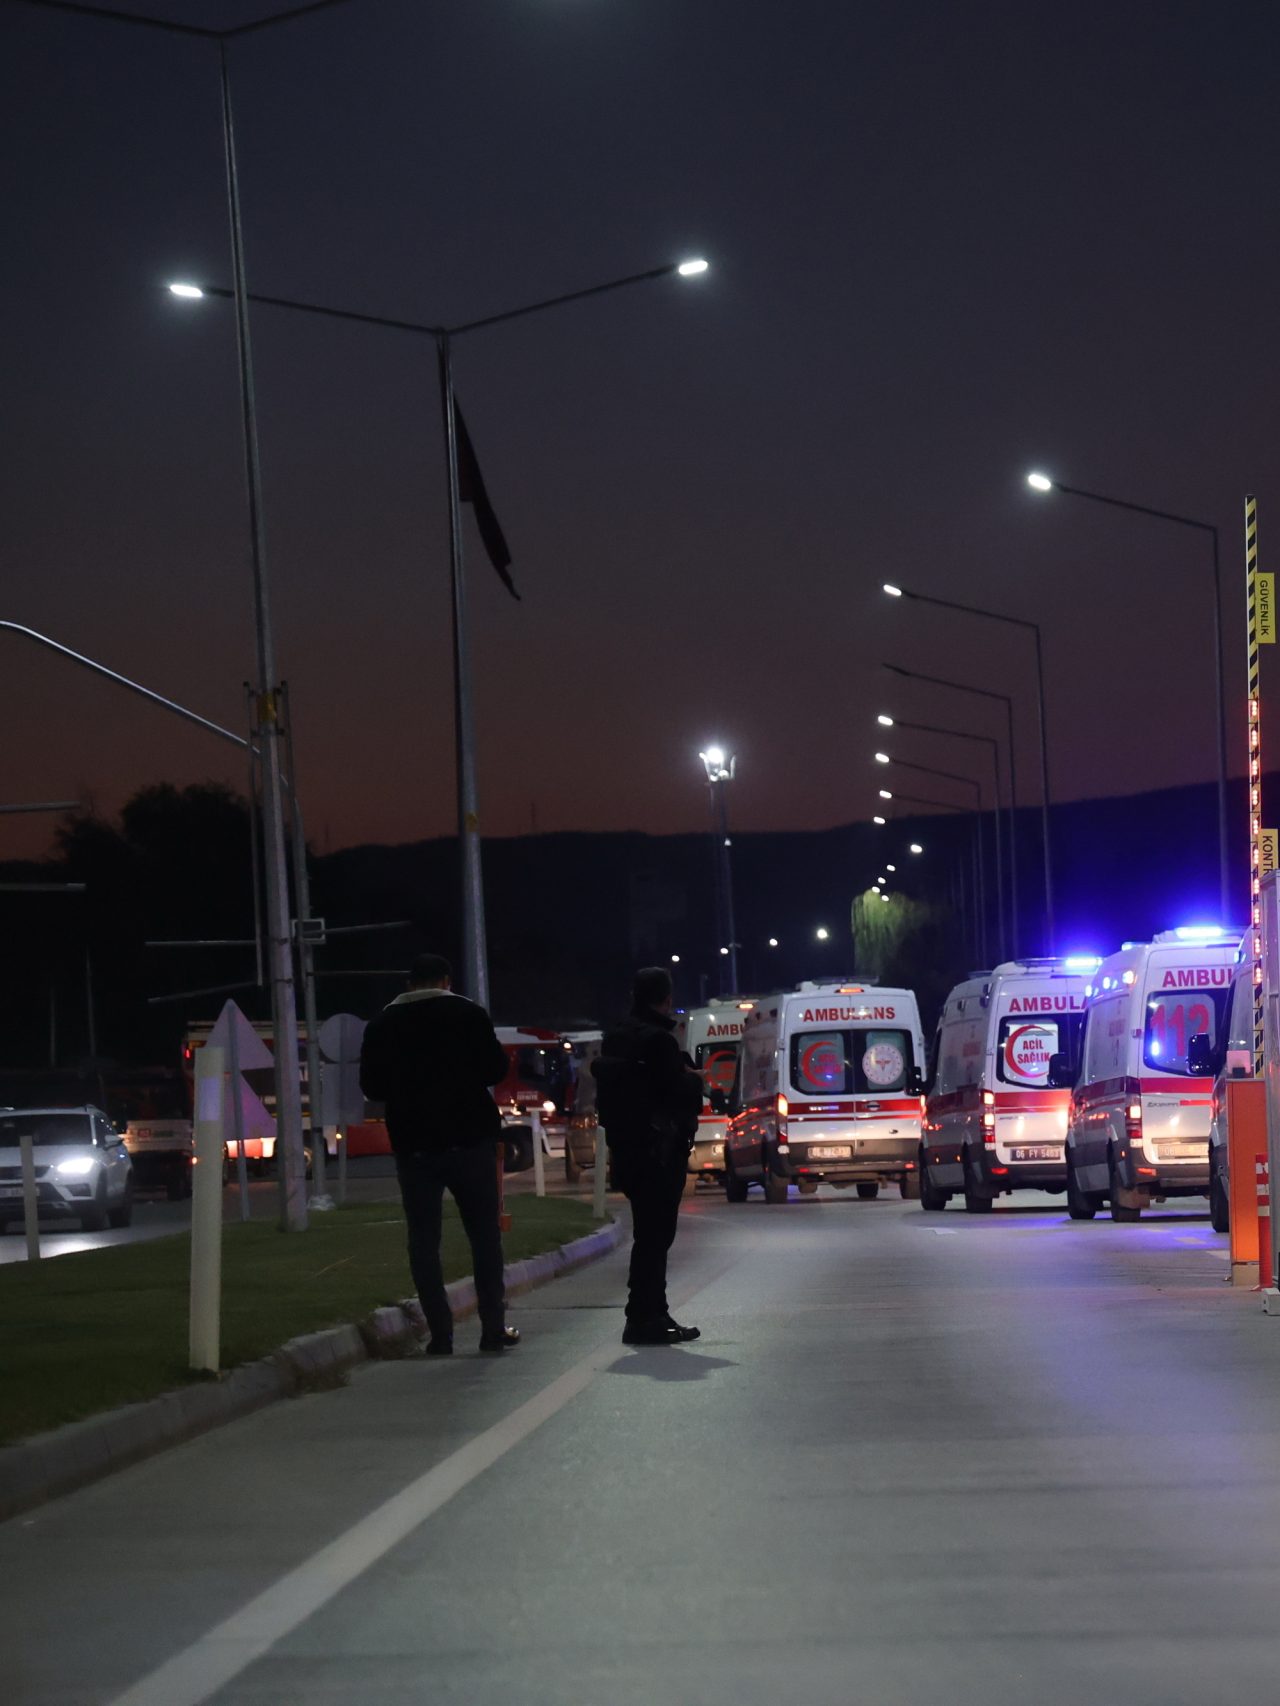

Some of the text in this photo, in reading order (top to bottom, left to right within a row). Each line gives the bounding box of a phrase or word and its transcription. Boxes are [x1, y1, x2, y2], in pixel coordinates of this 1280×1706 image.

[1259, 579, 1271, 636] GÜVENLİK
[802, 1006, 896, 1022] AMBULANS
[1022, 1038, 1044, 1051] ACİL
[1017, 1051, 1050, 1064] SAĞLIK
